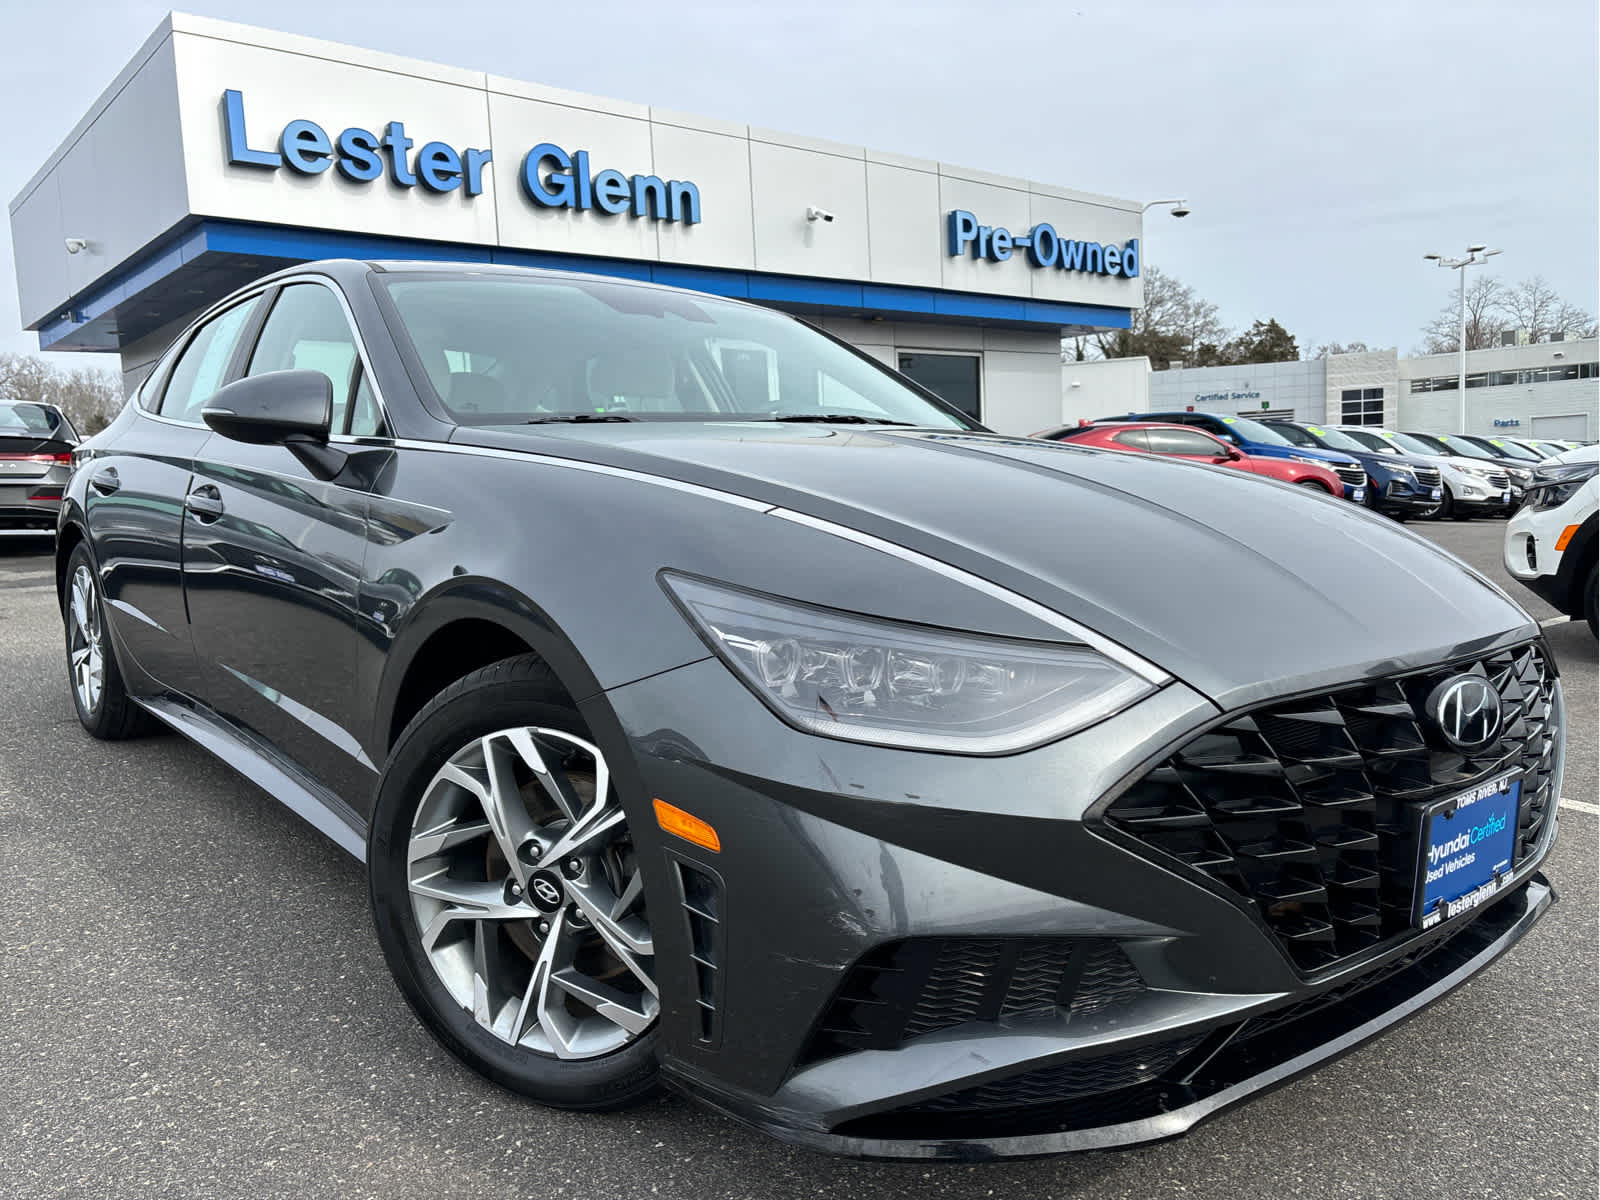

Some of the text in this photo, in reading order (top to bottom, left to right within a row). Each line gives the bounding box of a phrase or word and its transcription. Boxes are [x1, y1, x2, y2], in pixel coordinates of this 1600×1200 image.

[222, 89, 701, 225] Lester Glenn
[948, 209, 1139, 278] Pre-Owned
[1195, 391, 1261, 402] Certified Service
[1494, 418, 1521, 428] Parts
[1456, 791, 1477, 809] TOMS
[1470, 813, 1506, 844] Certified
[1445, 852, 1476, 875] Vehicles
